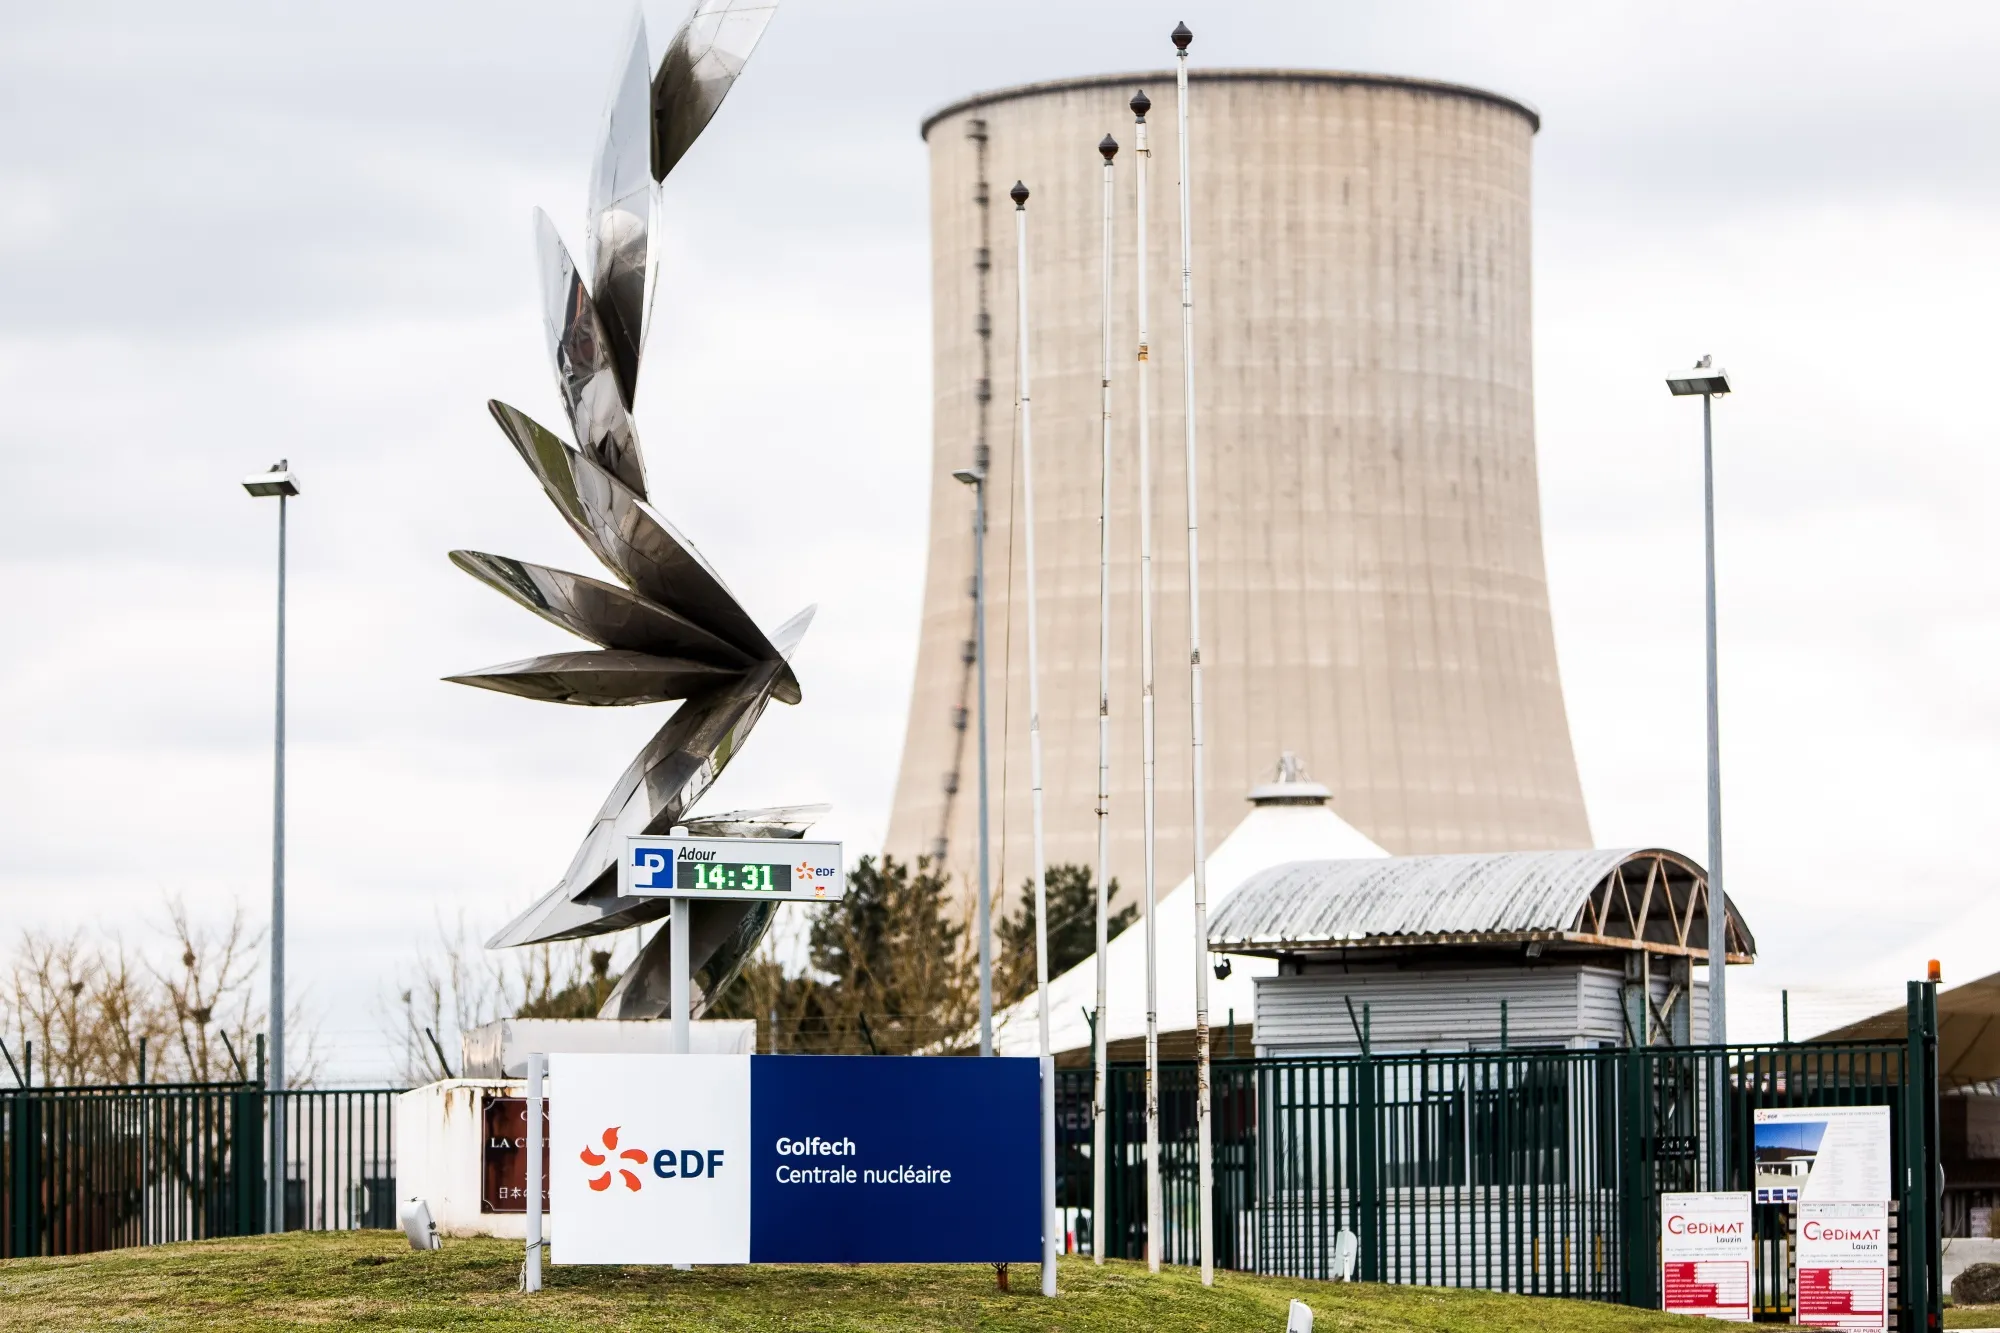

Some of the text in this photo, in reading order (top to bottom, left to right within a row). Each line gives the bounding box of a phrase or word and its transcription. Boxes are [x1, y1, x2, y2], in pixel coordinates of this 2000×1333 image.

[677, 846, 717, 861] Adour
[693, 863, 774, 891] 14:31
[815, 867, 836, 877] eDF
[490, 1137, 511, 1148] LA
[775, 1137, 856, 1156] Golfech
[653, 1149, 725, 1179] eDF
[775, 1164, 952, 1184] Centrale nucléaire
[1716, 1234, 1742, 1244] Lauzin
[1852, 1241, 1878, 1250] Lauzin
